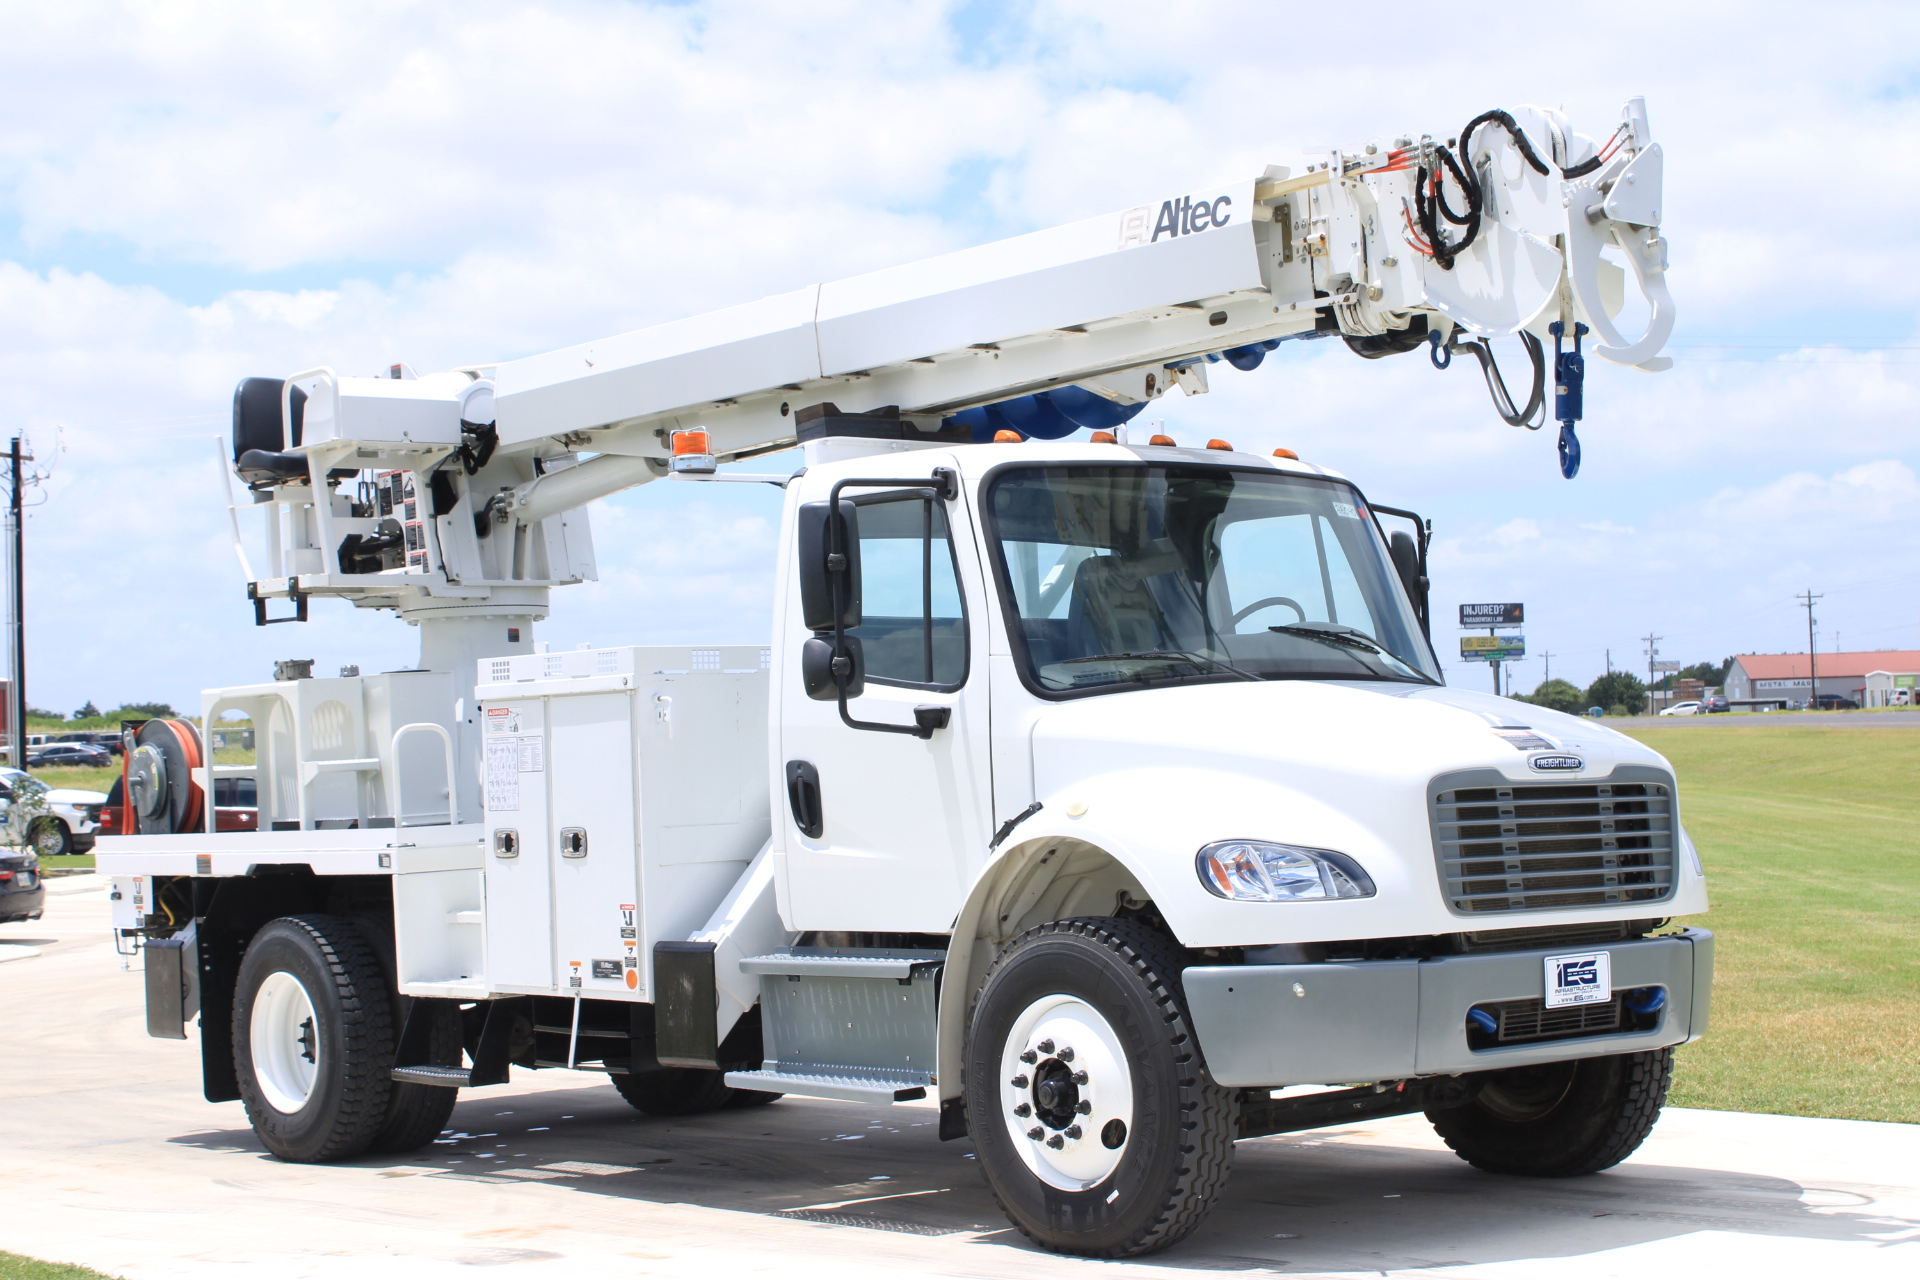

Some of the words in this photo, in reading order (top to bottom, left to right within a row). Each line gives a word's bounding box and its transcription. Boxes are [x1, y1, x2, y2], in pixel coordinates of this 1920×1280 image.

[1150, 195, 1232, 243] Altec
[1463, 605, 1504, 615] INJURED?
[1536, 757, 1580, 768] FREIGHTLINER
[1554, 984, 1601, 994] INFRASTRUCTURE
